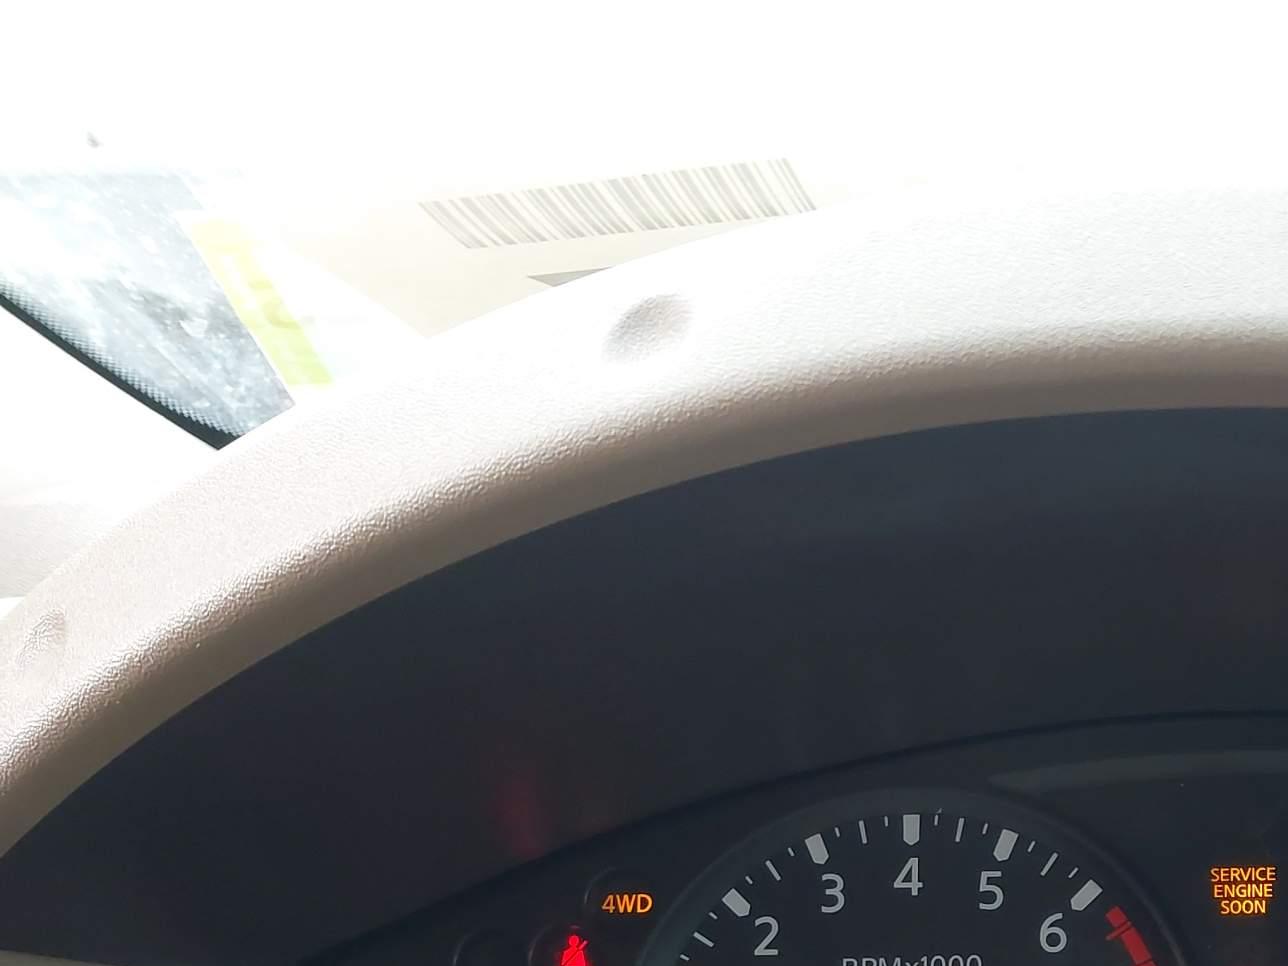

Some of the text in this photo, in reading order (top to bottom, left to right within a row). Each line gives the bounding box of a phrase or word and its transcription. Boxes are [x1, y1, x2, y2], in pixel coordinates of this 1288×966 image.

[822, 874, 845, 912] 3
[894, 858, 922, 895] 4
[980, 871, 1003, 909] 5
[1210, 867, 1276, 882] SERVICE
[1213, 883, 1273, 898] ENGINE
[602, 894, 653, 913] 4WD
[1220, 900, 1266, 915] SOON
[753, 919, 778, 956] 2
[1040, 913, 1066, 952] 6
